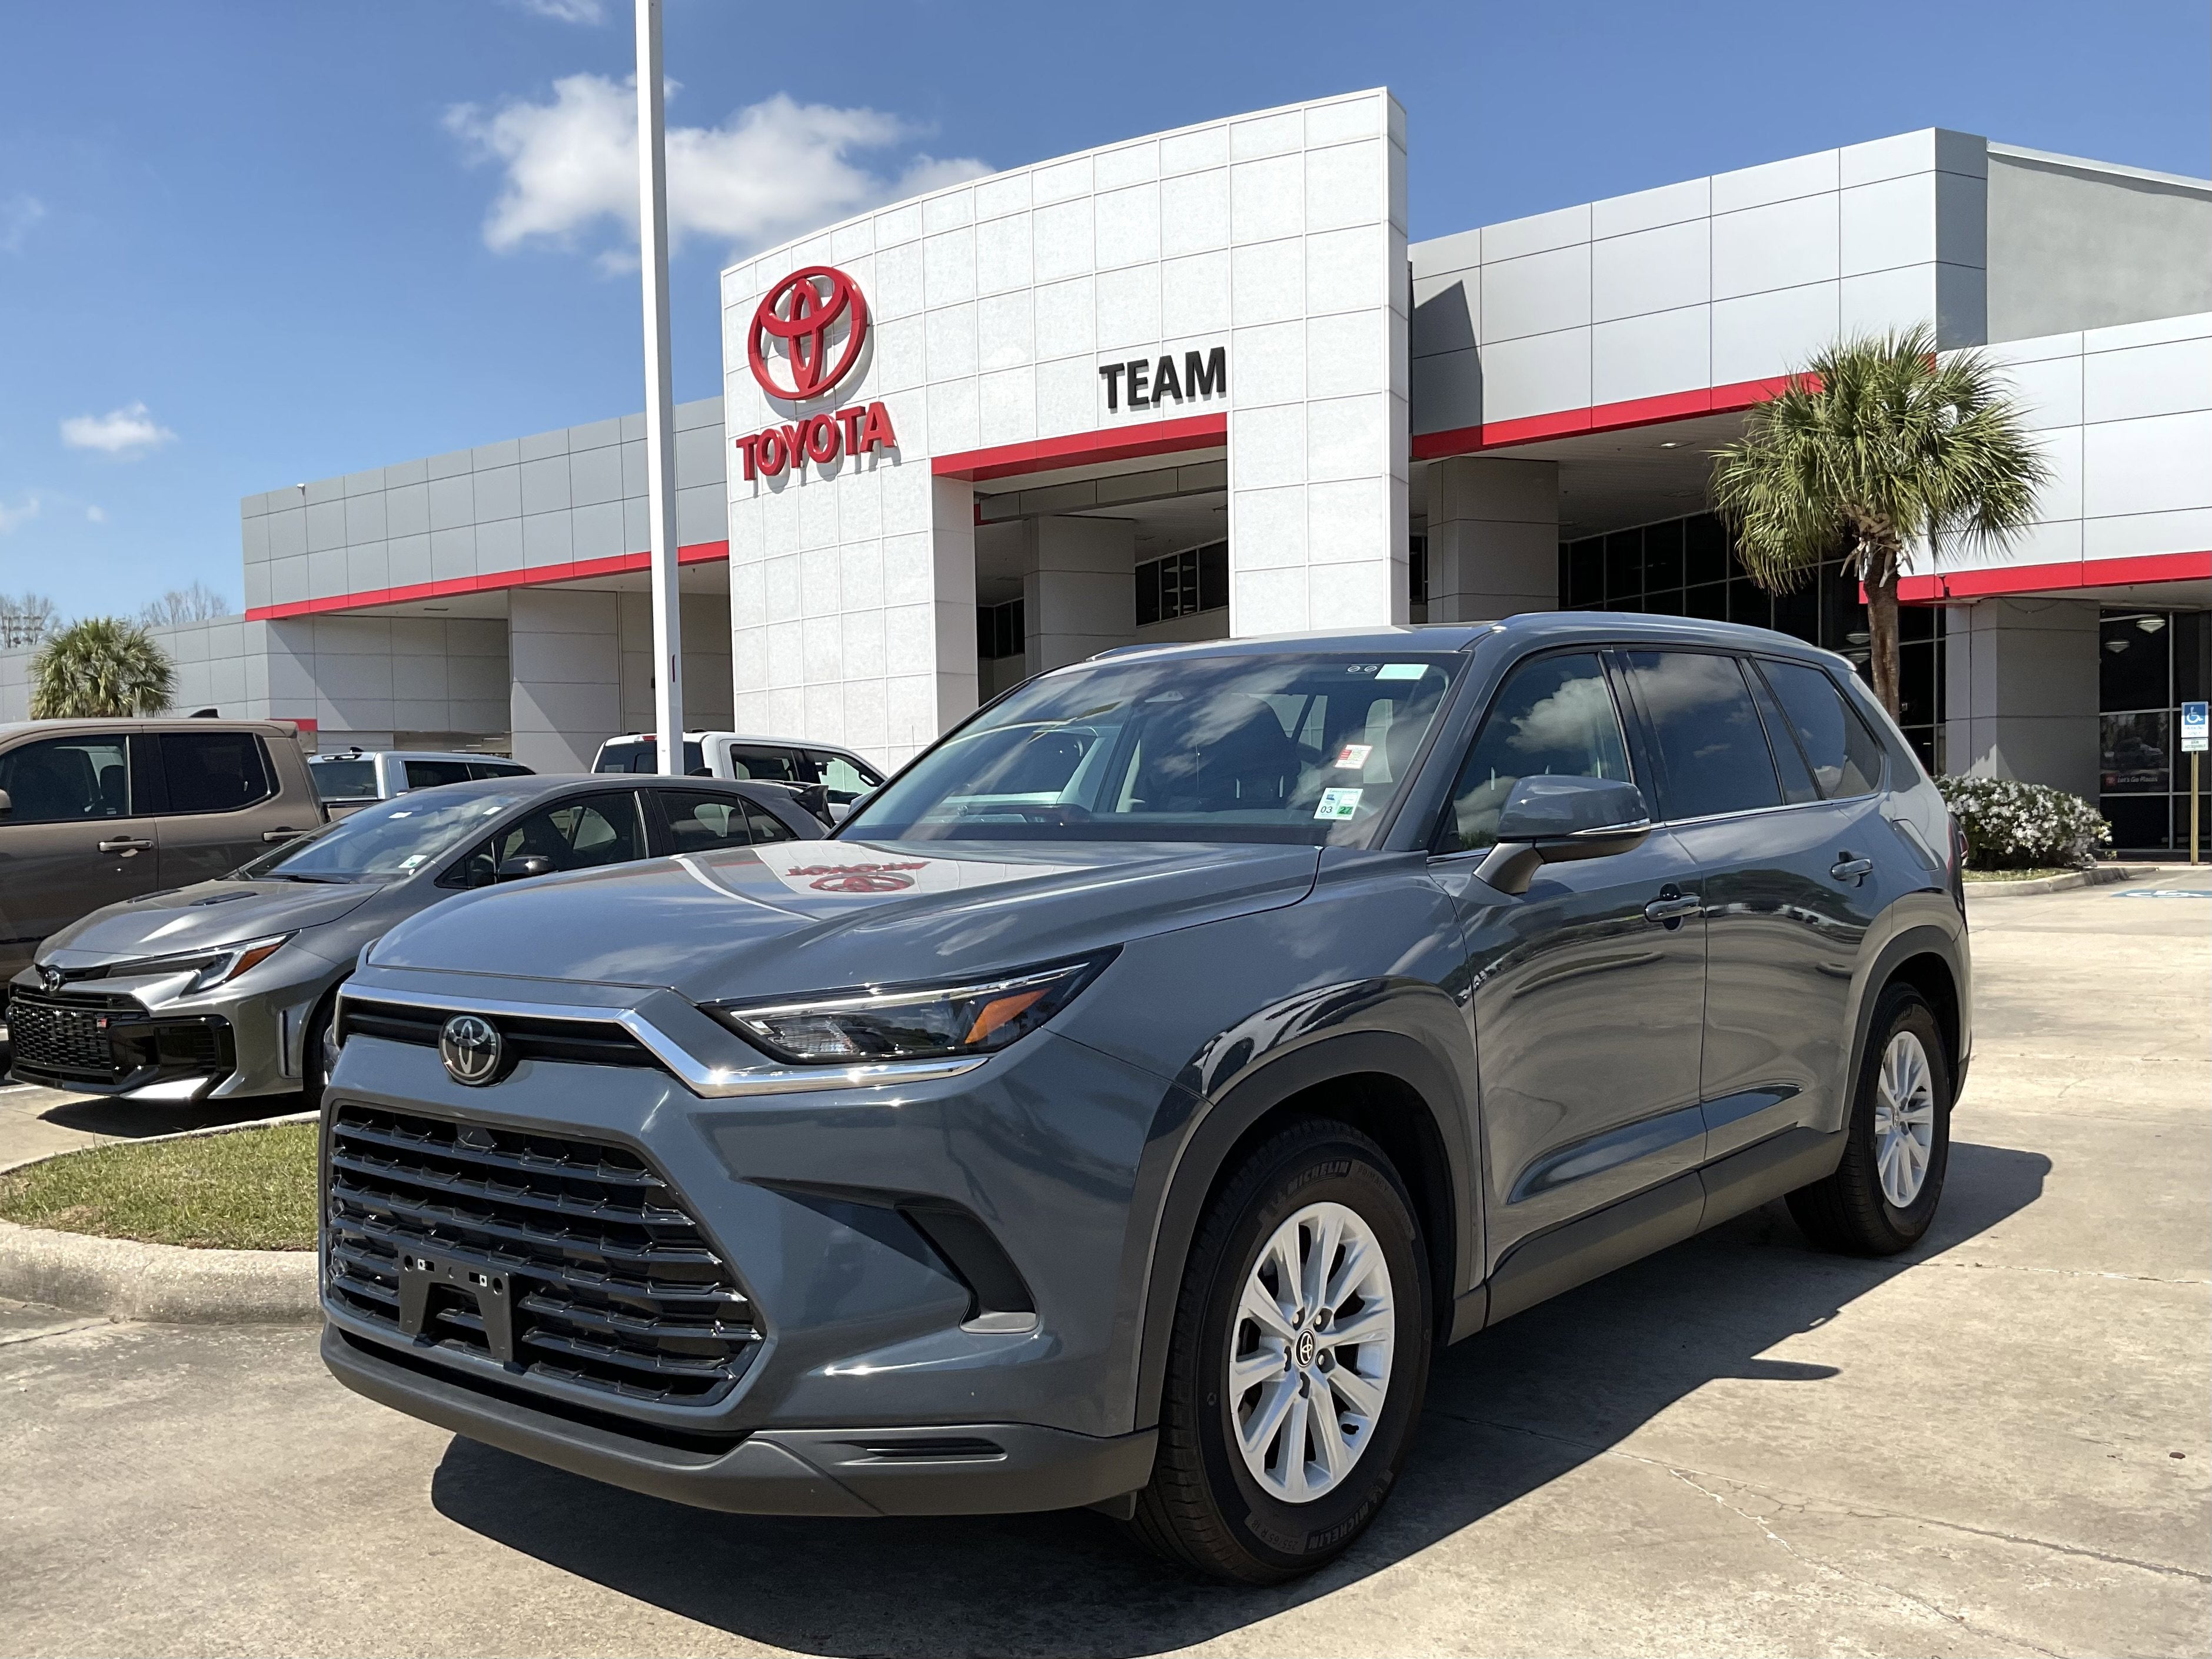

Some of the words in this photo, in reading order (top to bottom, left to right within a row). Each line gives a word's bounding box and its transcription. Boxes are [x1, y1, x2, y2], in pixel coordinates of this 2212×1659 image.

[1099, 347, 1226, 409] TEAM
[736, 402, 896, 480] TOYOTA
[1287, 1161, 1349, 1196] MICHELIN
[1308, 1502, 1369, 1550] MICHELIN
